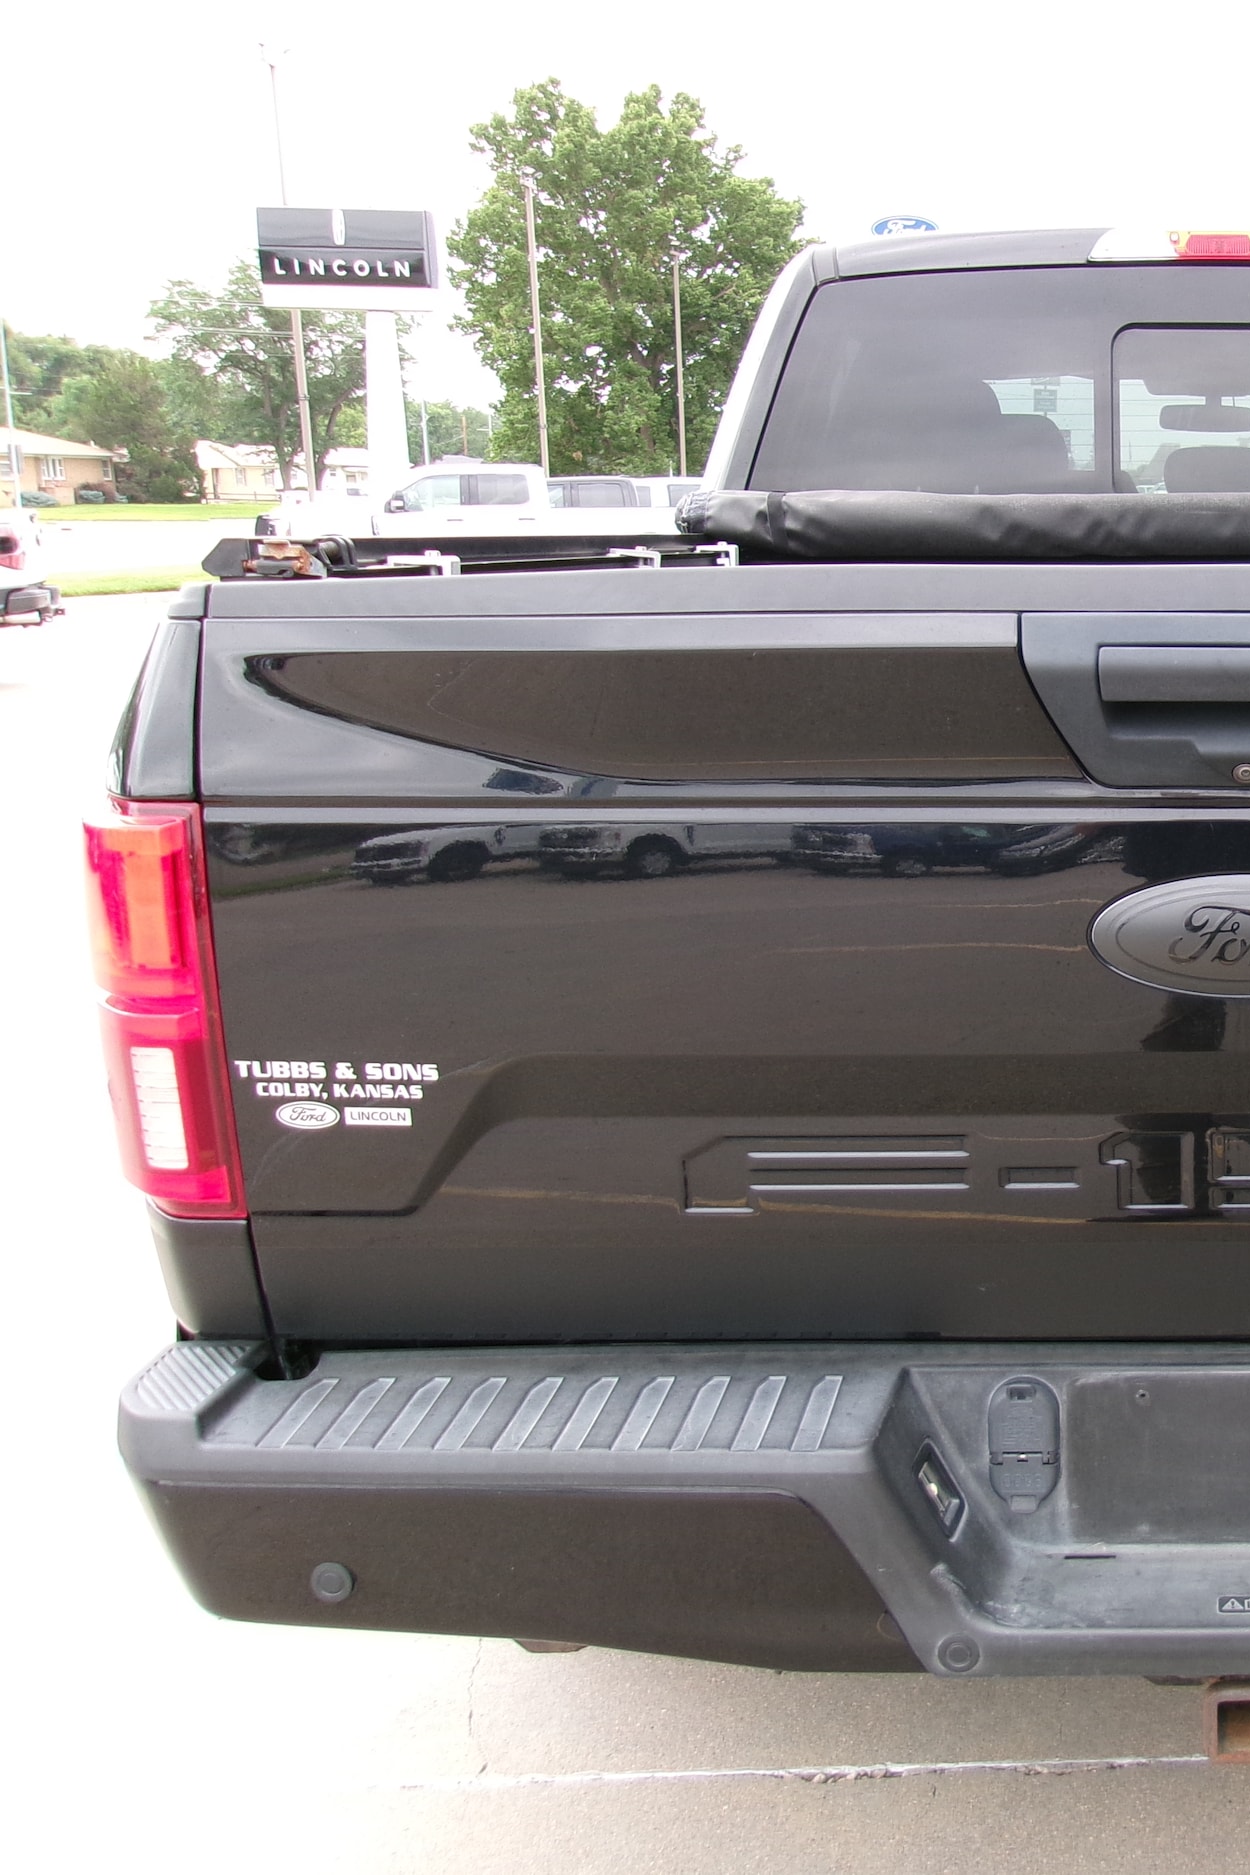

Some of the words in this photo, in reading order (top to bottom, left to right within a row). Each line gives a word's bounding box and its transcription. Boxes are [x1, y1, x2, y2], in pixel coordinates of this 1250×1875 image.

[273, 257, 411, 278] LINCOLN
[234, 1060, 327, 1079] TUBBS
[335, 1062, 357, 1080] &
[365, 1062, 439, 1081] SONS
[256, 1082, 328, 1100] COLBY,
[333, 1084, 423, 1099] KANSAS
[289, 1106, 327, 1122] Ford
[349, 1111, 407, 1121] LINCOLN
